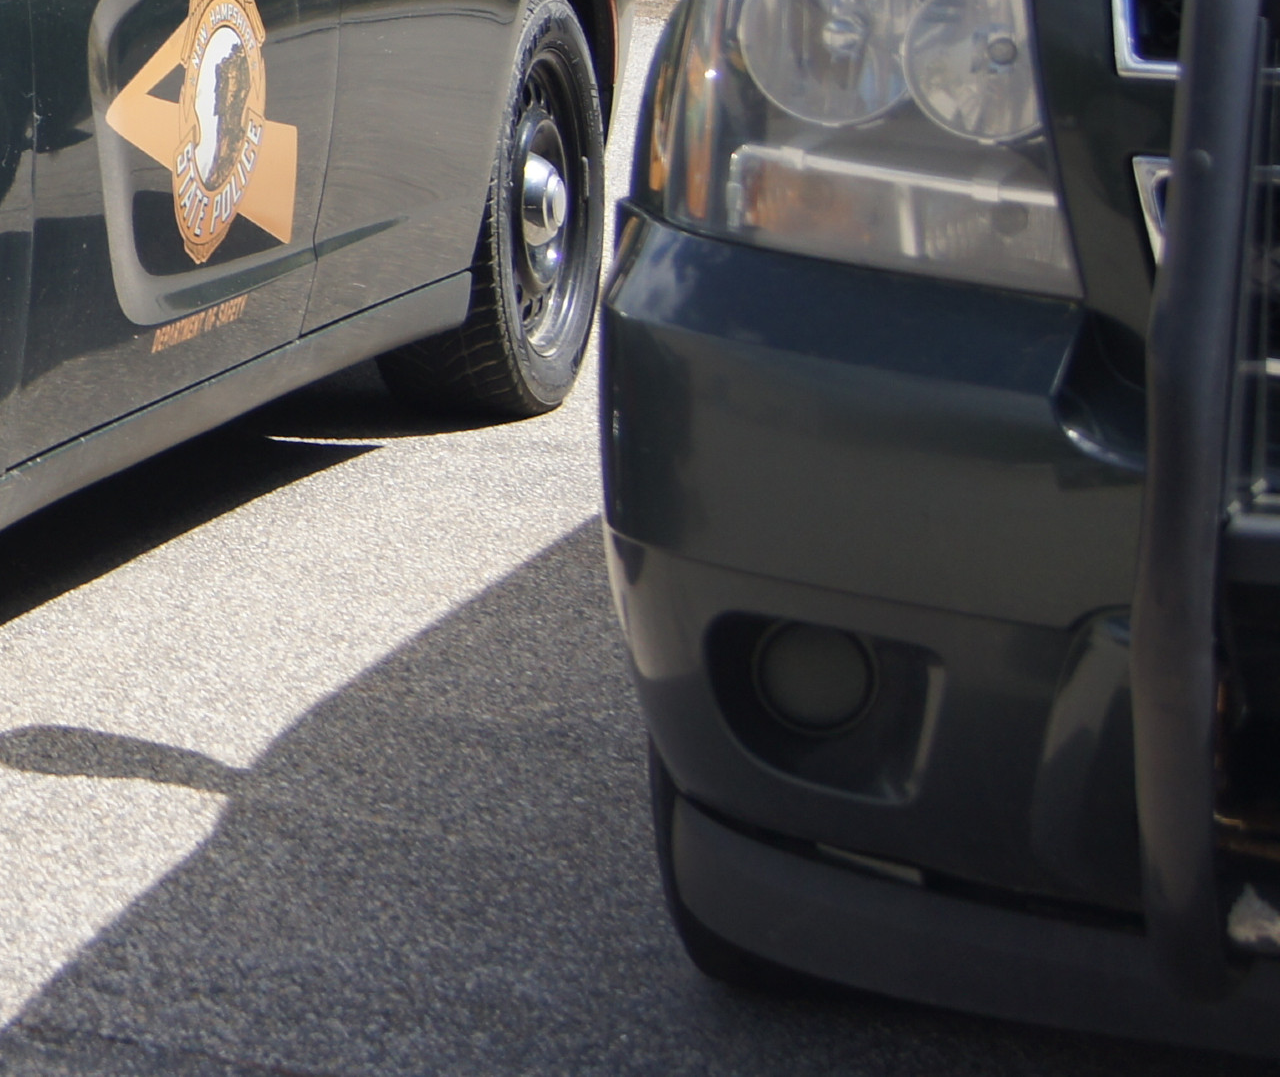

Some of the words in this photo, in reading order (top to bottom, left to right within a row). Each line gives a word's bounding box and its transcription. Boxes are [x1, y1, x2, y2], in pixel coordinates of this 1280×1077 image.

[191, 25, 209, 70] NEW
[209, 2, 255, 53] HAMPSHIRE
[176, 142, 210, 237] STATE
[209, 118, 263, 235] POLICE
